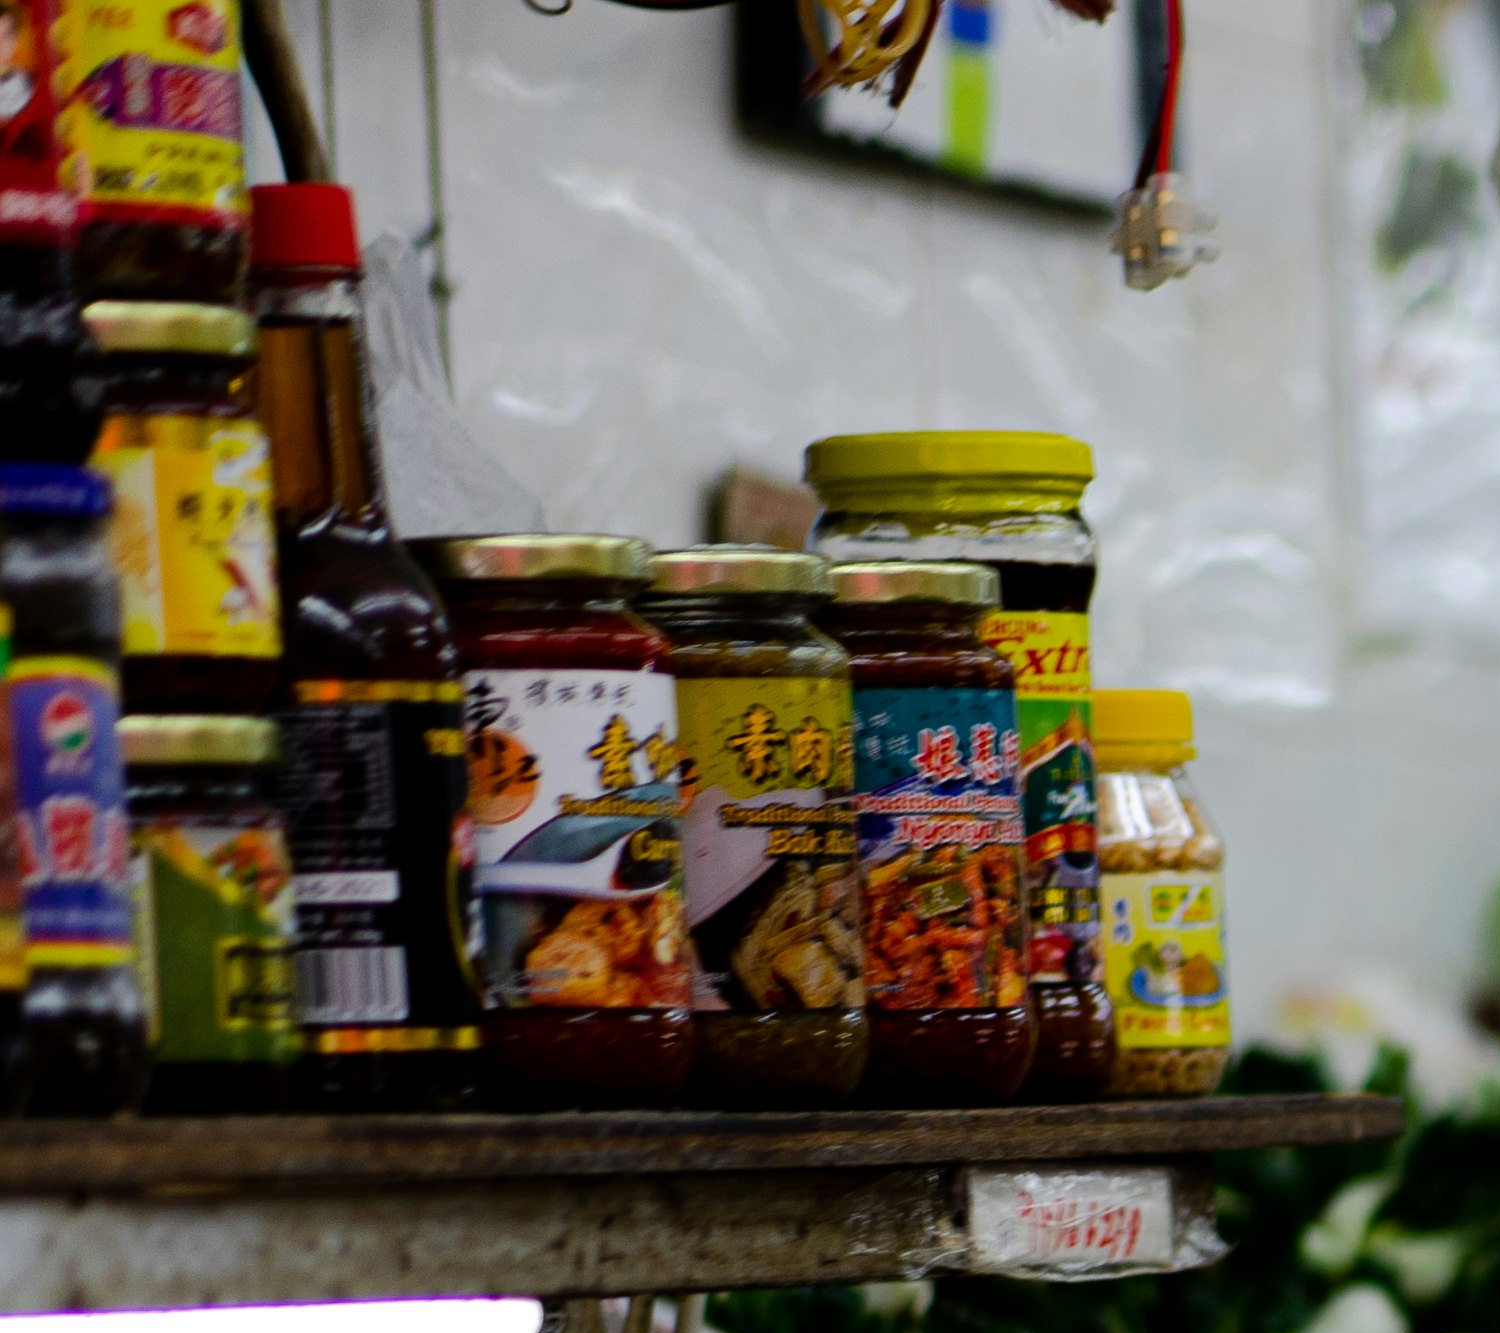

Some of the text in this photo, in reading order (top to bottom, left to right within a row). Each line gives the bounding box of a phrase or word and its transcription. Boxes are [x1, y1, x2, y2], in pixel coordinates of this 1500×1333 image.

[852, 790, 971, 816] Traditional
[766, 827, 824, 858] Bak
[892, 814, 1000, 852] Nyonya
